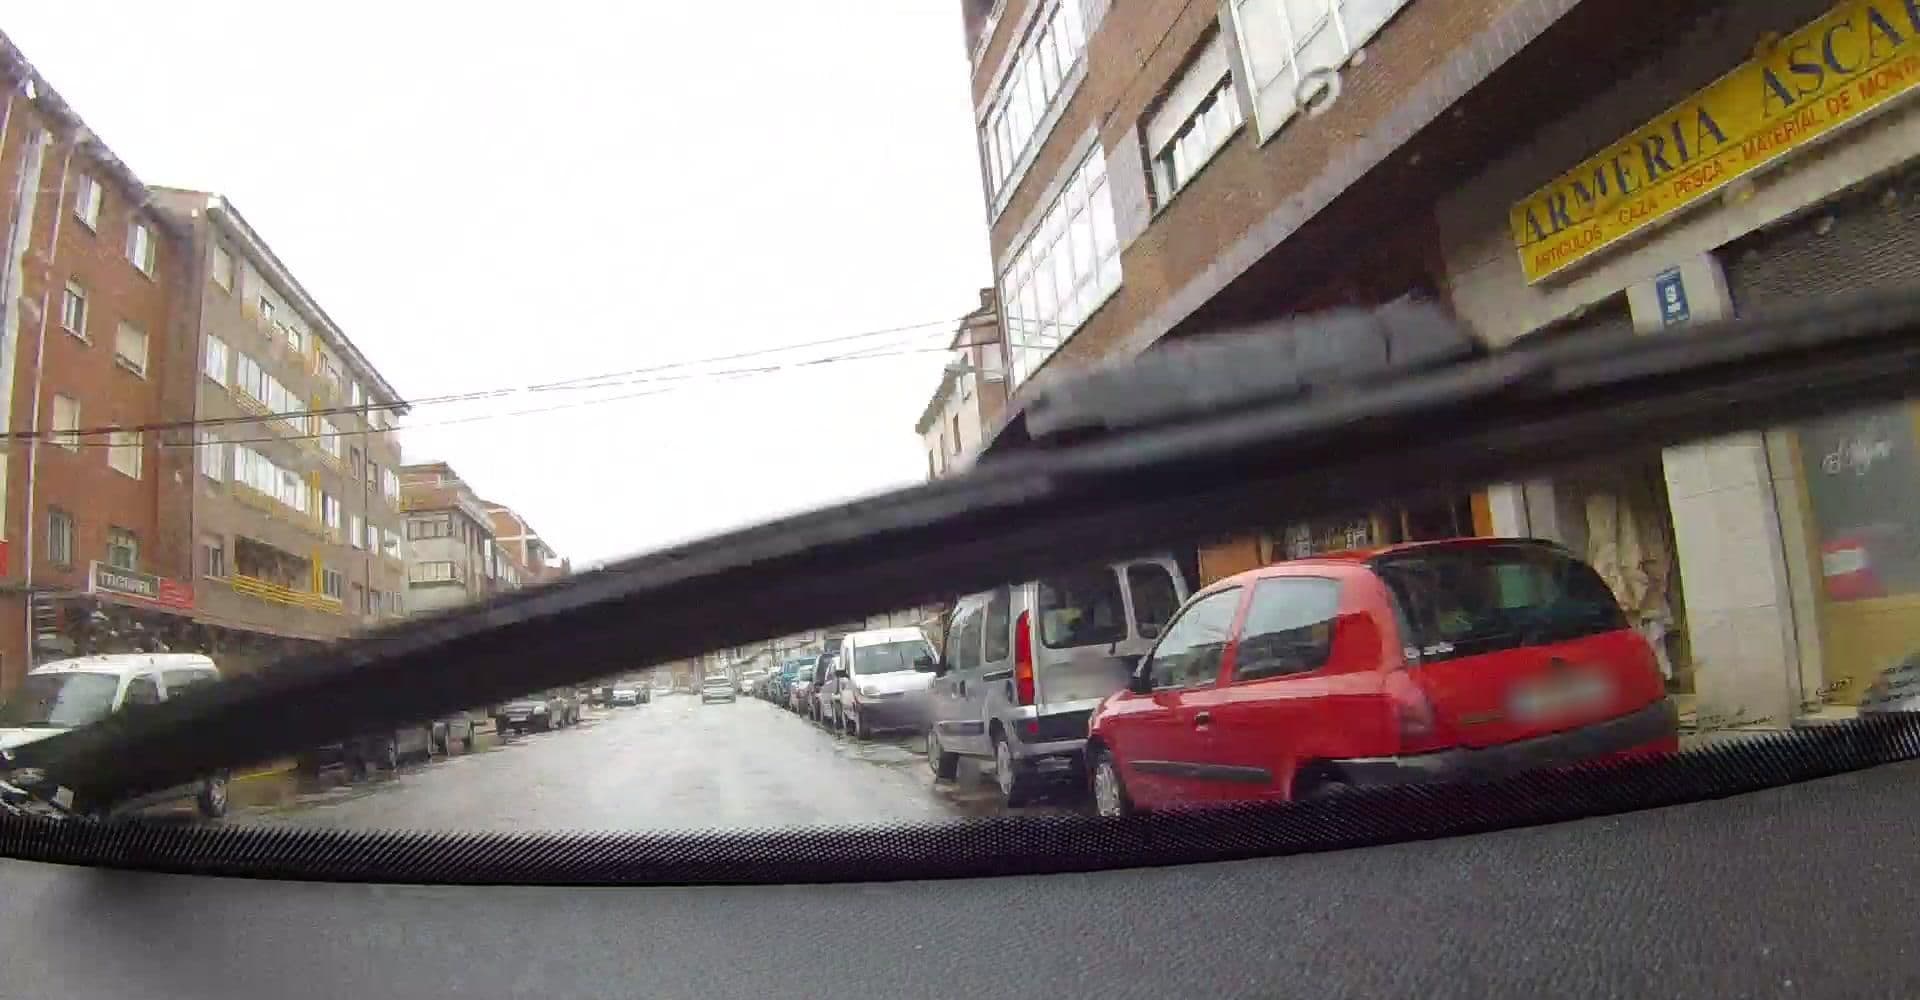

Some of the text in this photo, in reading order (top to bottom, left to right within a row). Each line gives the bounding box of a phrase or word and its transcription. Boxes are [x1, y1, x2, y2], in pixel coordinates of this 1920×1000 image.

[1522, 105, 1729, 245] ARMERIA
[1672, 161, 1722, 200] PESCA
[1742, 108, 1825, 161] MATERIAL
[1825, 89, 1852, 117] DE
[1858, 52, 1920, 101] MONT
